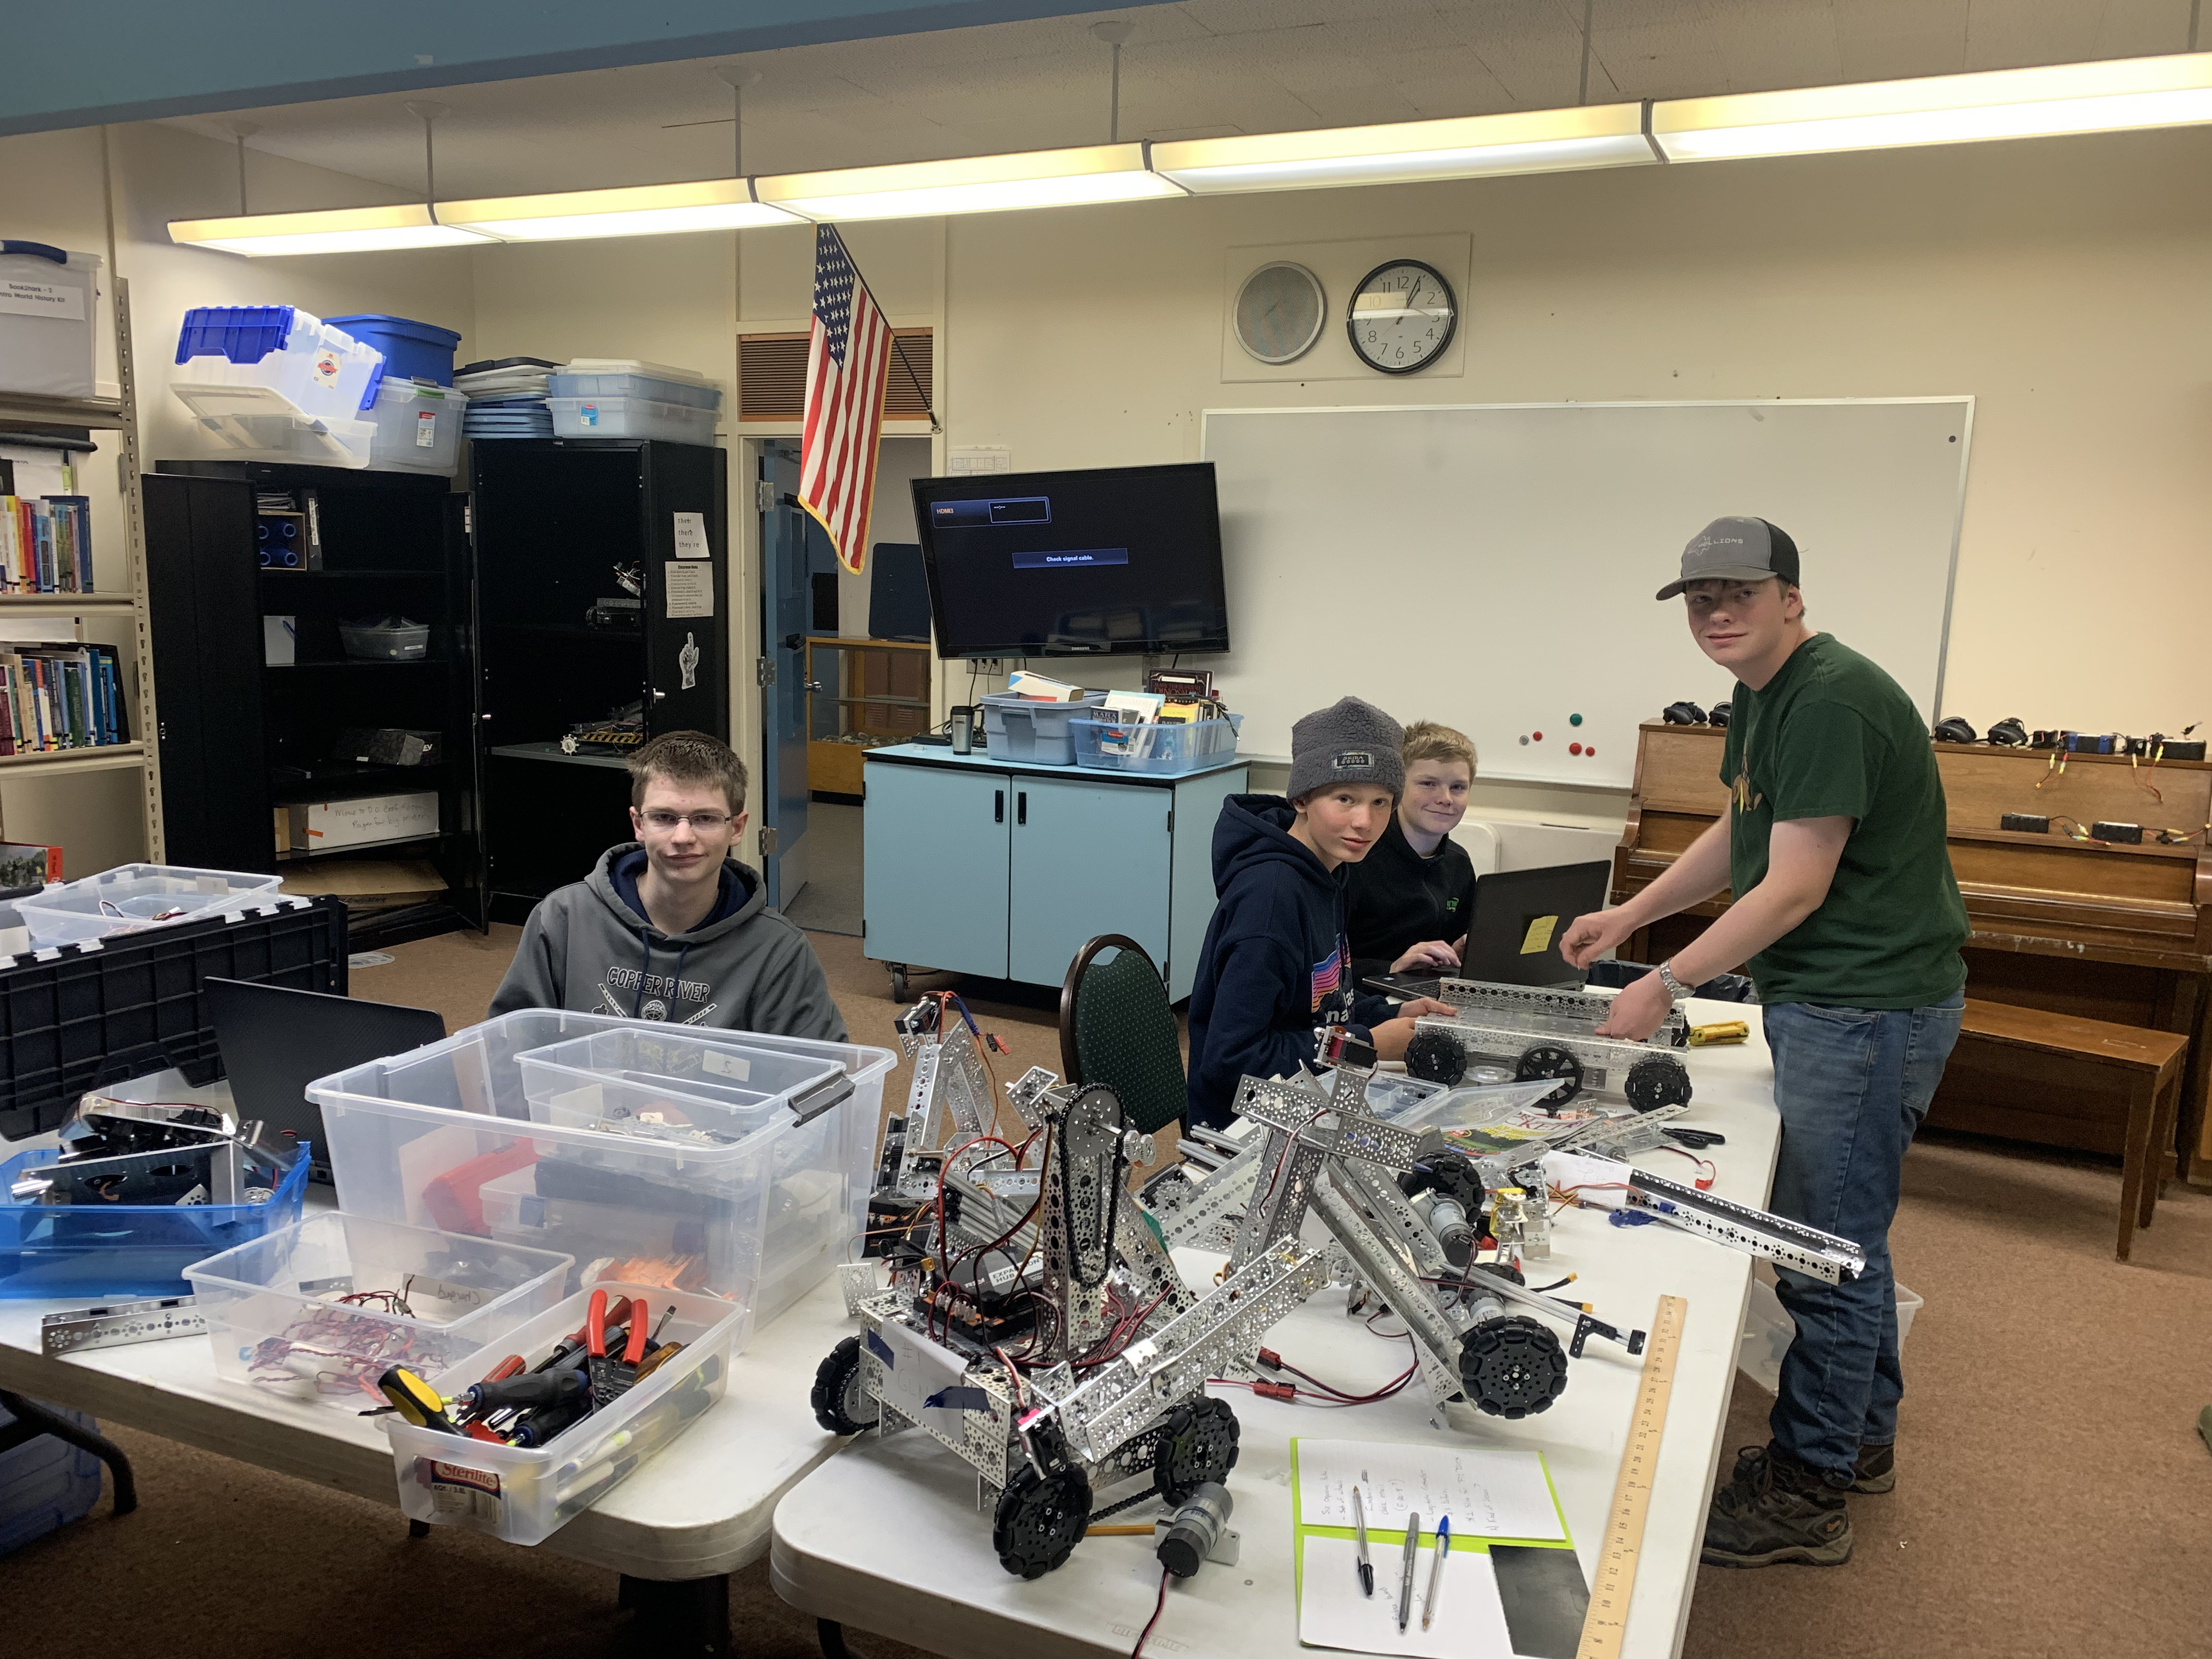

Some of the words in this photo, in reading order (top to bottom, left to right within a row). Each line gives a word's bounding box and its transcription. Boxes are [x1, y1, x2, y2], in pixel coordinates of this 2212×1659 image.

[9, 284, 42, 292] BookShark
[1383, 281, 1391, 294] 11
[1397, 276, 1409, 289] 12
[35, 295, 55, 303] History
[1369, 295, 1381, 308] 10
[1427, 291, 1436, 304] 2
[1368, 330, 1377, 343] 8
[1425, 328, 1435, 340] 4
[1381, 343, 1389, 355] 7
[1396, 347, 1404, 359] 6
[1413, 341, 1421, 353] 5
[679, 541, 699, 549] they're
[1093, 710, 1117, 719] MARA
[422, 743, 433, 752] EV
[607, 967, 663, 996] COPPER
[992, 1259, 1040, 1279] EXPAON
[996, 1273, 1015, 1283] HUB
[442, 1463, 493, 1486] Sterilite
[1605, 1583, 1615, 1592] 11
[1601, 1599, 1611, 1608] 10
[1111, 1624, 1180, 1652] LIFTIME
